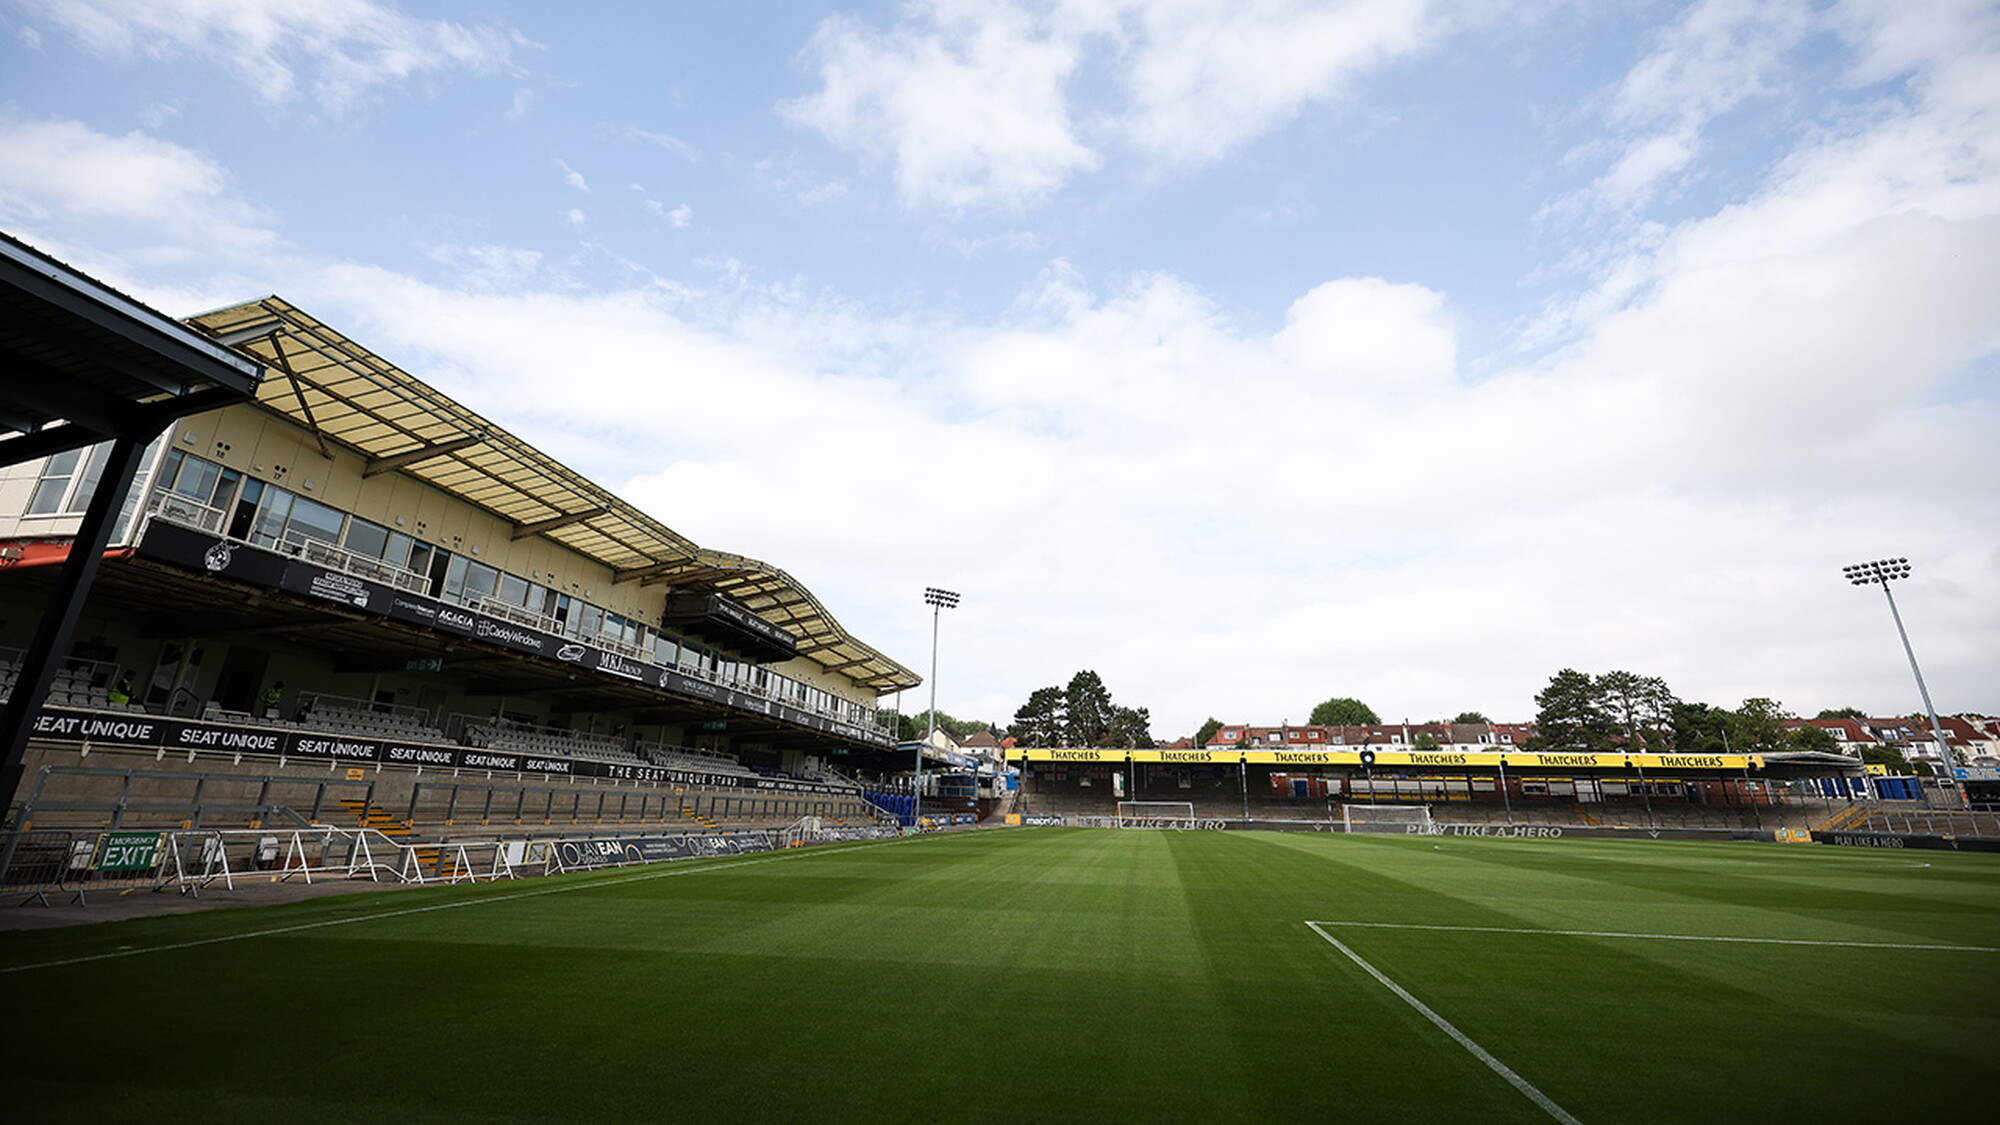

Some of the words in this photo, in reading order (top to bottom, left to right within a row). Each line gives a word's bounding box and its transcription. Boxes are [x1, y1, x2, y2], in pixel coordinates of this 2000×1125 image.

[438, 609, 474, 627] ACACIA
[80, 720, 154, 740] UNIQUE
[179, 728, 221, 745] SEAT
[222, 733, 278, 751] UNIQUE
[297, 739, 330, 754] SEAT
[330, 742, 375, 758] UNIQUE
[1050, 750, 1101, 760] THATCHERS
[389, 748, 415, 760] SEAT
[416, 750, 452, 763] UNIQUE
[465, 754, 486, 766] SEAT
[486, 756, 517, 768] UNIQUE
[1160, 751, 1212, 761] THATCHERS
[1274, 752, 1329, 763] THATCHERS
[1409, 753, 1467, 765] THATCHERS
[1537, 755, 1598, 766] THATCHERS
[1659, 756, 1723, 767] THATCHERS
[526, 759, 544, 770] SEAT
[544, 761, 569, 772] UNIQUE
[608, 765, 632, 778] THE
[637, 767, 665, 781] SEAT
[670, 772, 707, 784] UNIQUE
[710, 776, 738, 787] STAND
[1026, 817, 1060, 826] macron
[1453, 825, 1491, 836] LIKE
[1495, 827, 1508, 837] A
[1513, 827, 1562, 838] HERO
[109, 836, 157, 845] EMERGENCY
[1834, 835, 1853, 846] PLAY
[1854, 836, 1871, 847] LIKE
[1880, 837, 1904, 848] HERO
[102, 846, 153, 866] EXIT
